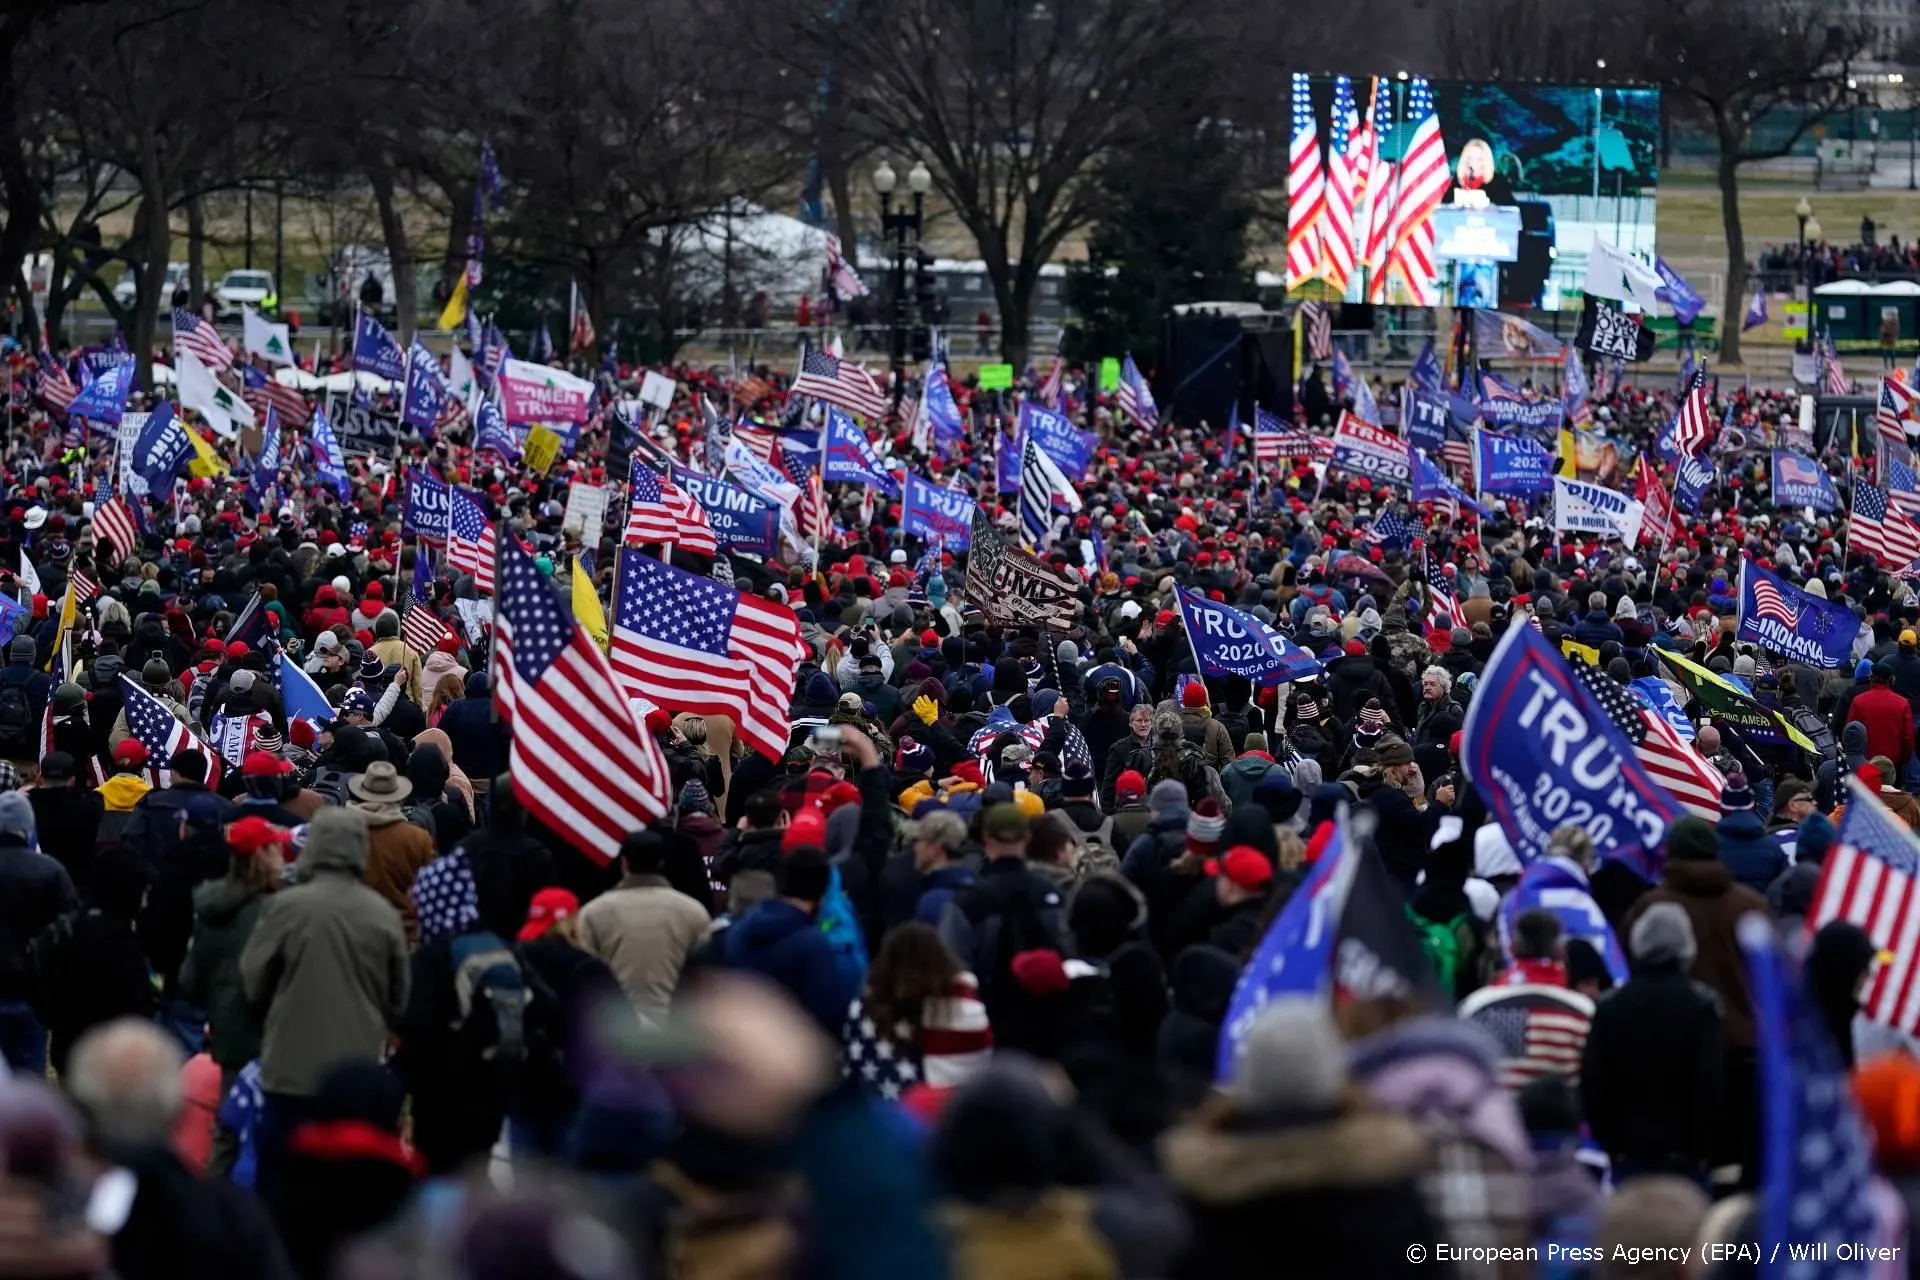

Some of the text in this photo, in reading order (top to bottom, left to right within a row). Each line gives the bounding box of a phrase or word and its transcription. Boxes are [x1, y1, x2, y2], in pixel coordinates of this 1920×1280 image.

[1591, 330, 1638, 357] FEAR
[1491, 400, 1552, 417] MARYLAND
[1488, 437, 1548, 454] TRUM
[1346, 450, 1409, 480] 2020
[676, 474, 768, 514] RUMP
[913, 481, 974, 525] TRUM
[1784, 484, 1835, 505] MONTA
[1566, 515, 1579, 526] NO
[1581, 517, 1607, 529] MORE
[1011, 598, 1038, 617] Order
[1758, 618, 1824, 664] INDIANA
[1759, 636, 1781, 654] FOR
